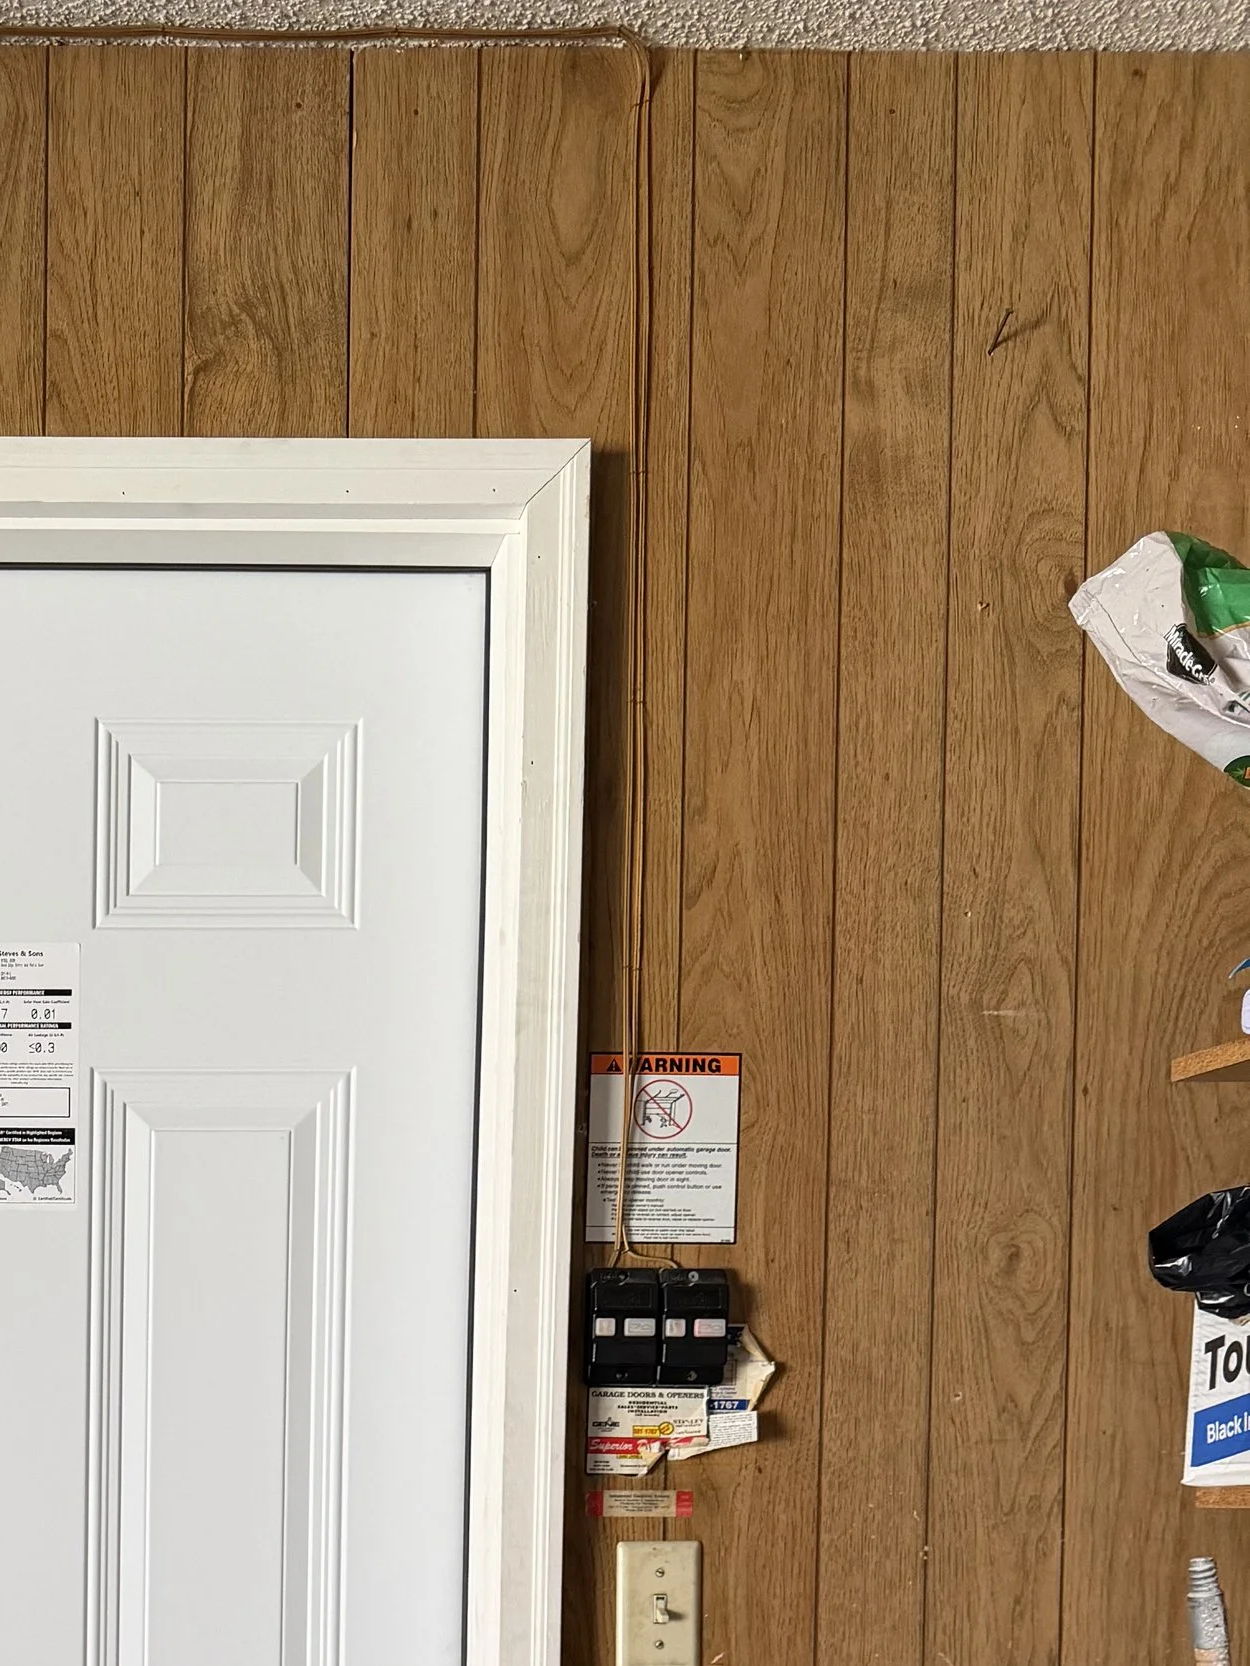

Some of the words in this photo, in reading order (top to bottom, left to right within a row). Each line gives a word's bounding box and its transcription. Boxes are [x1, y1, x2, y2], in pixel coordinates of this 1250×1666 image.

[31, 1008, 56, 1020] 0.01
[28, 1042, 55, 1053] ≤0.3
[629, 1057, 722, 1073] ARNING
[1204, 1334, 1250, 1391] To
[666, 1391, 705, 1399] OPENERS
[1206, 1412, 1242, 1444] Black
[589, 1438, 633, 1452] Superior
